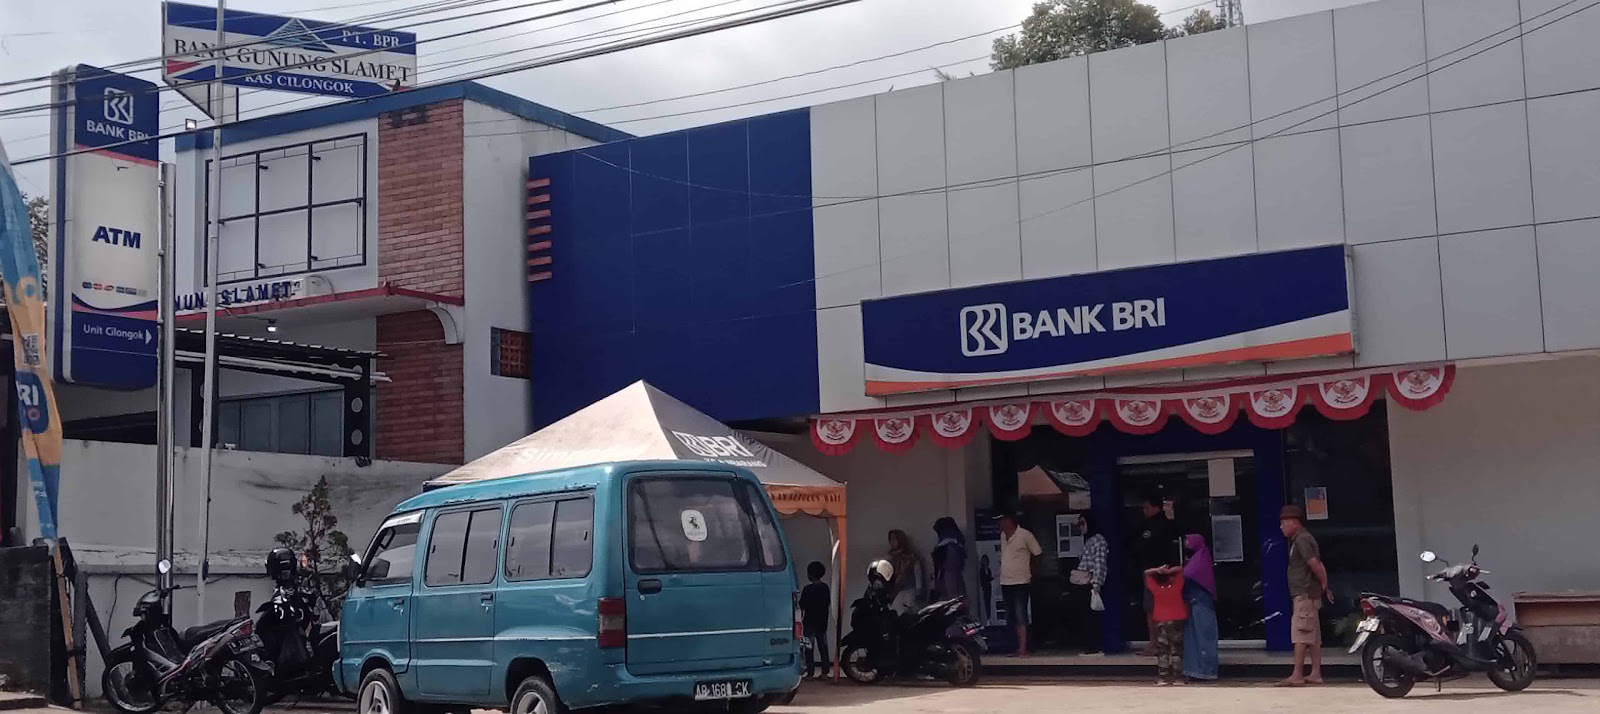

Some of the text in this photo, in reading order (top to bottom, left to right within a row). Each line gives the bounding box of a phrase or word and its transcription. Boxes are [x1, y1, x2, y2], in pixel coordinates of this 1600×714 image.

[341, 29, 400, 48] PT. BPR
[237, 47, 326, 72] GUNUNG
[331, 59, 411, 82] SLAMET
[244, 73, 354, 94] KAS CILONGOK
[86, 119, 149, 145] BANK BRI
[92, 225, 142, 249] ATM
[221, 281, 291, 306] SLAMET
[1012, 298, 1166, 341] BANK BRI
[83, 324, 144, 341] Unit Cilongok
[695, 435, 755, 457] BRI
